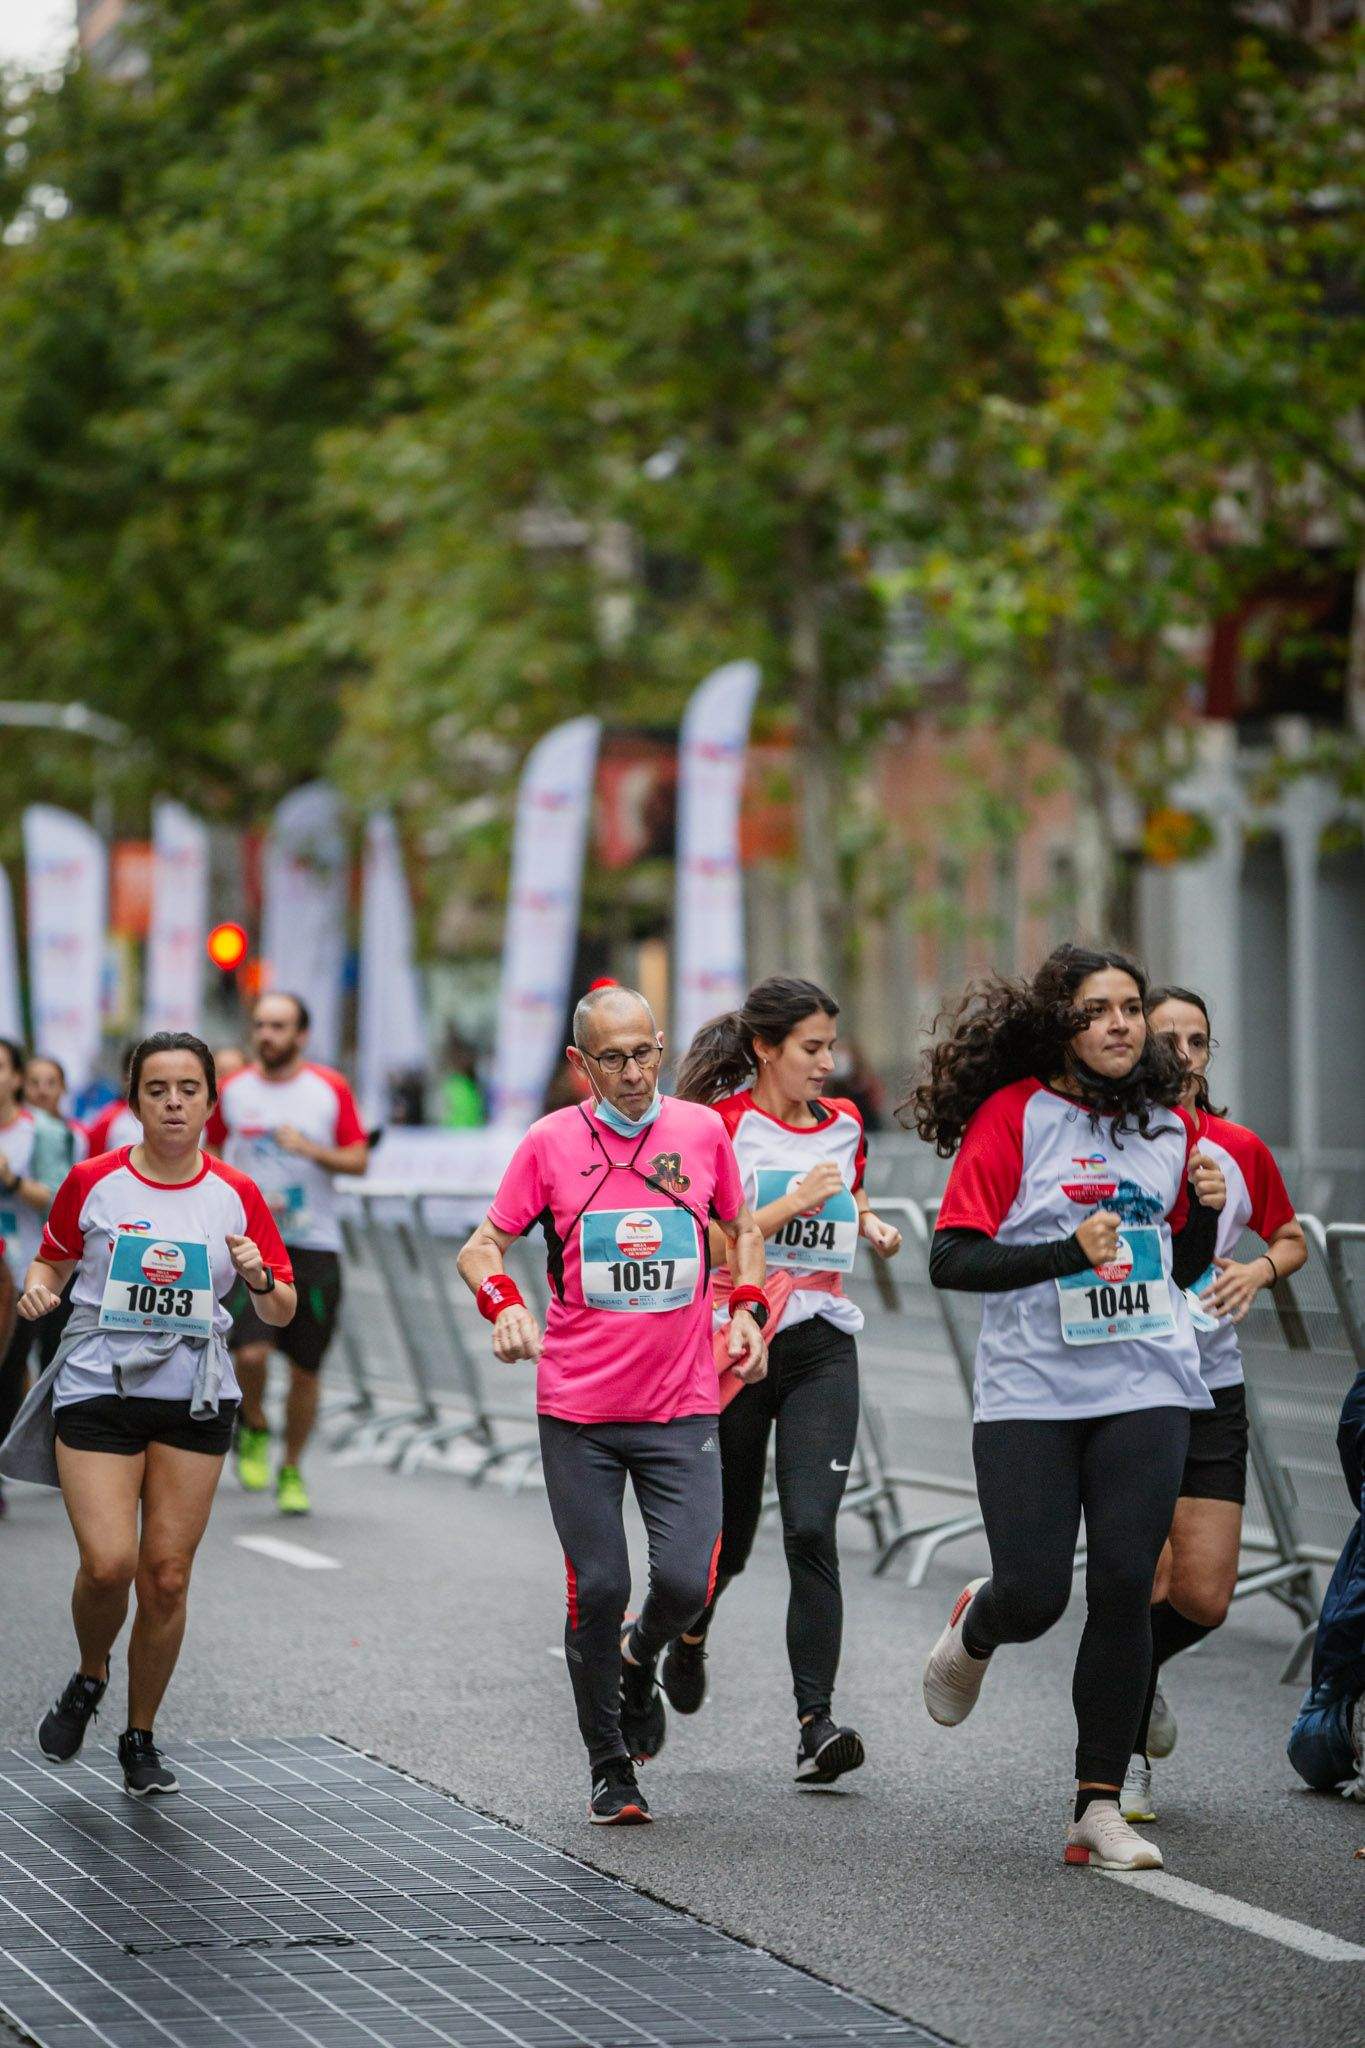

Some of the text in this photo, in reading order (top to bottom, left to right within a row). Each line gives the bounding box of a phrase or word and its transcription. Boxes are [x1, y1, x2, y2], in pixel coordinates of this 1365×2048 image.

[608, 1260, 675, 1292] 1057
[127, 1284, 193, 1317] 1033
[1085, 1282, 1150, 1320] 1044
